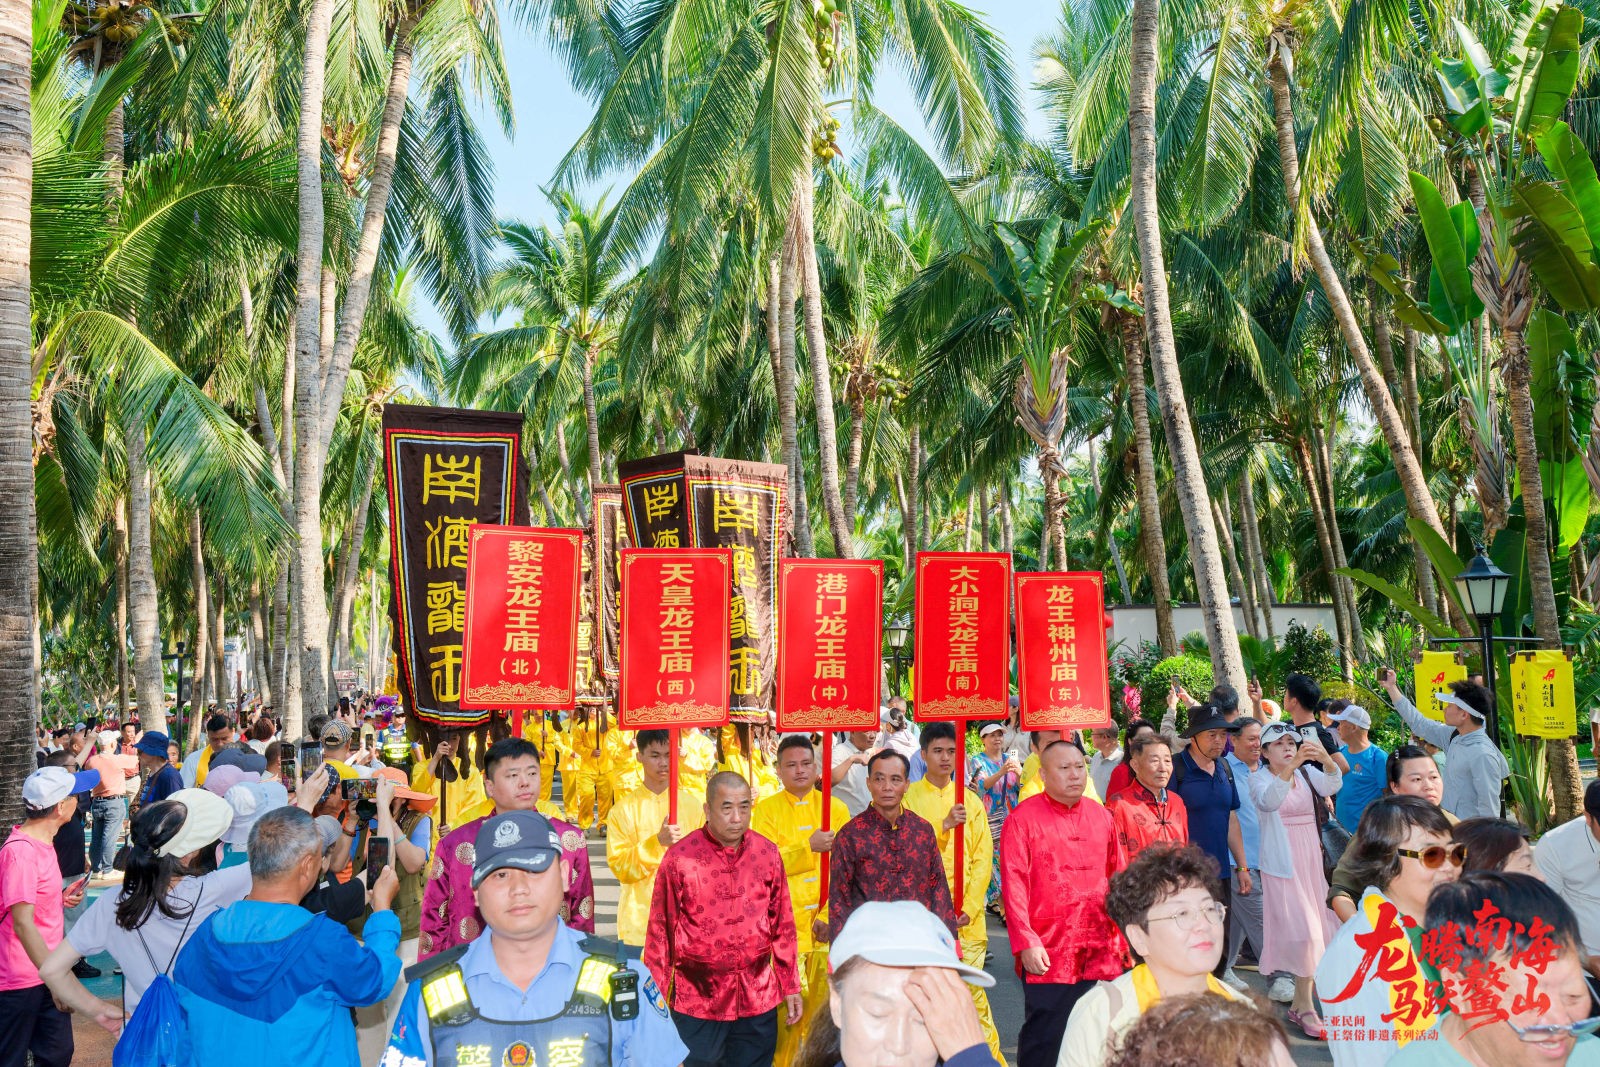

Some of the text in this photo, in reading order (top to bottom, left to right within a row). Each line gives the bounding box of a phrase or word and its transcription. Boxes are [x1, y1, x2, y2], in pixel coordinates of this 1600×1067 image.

[503, 540, 544, 653] 黎安龙王庙
[658, 563, 695, 674] 天皇龙王庙
[814, 572, 848, 680] 港门龙王庙
[947, 565, 980, 674] 大小洞天龙王庙
[1045, 584, 1078, 682] 龙王神州庙
